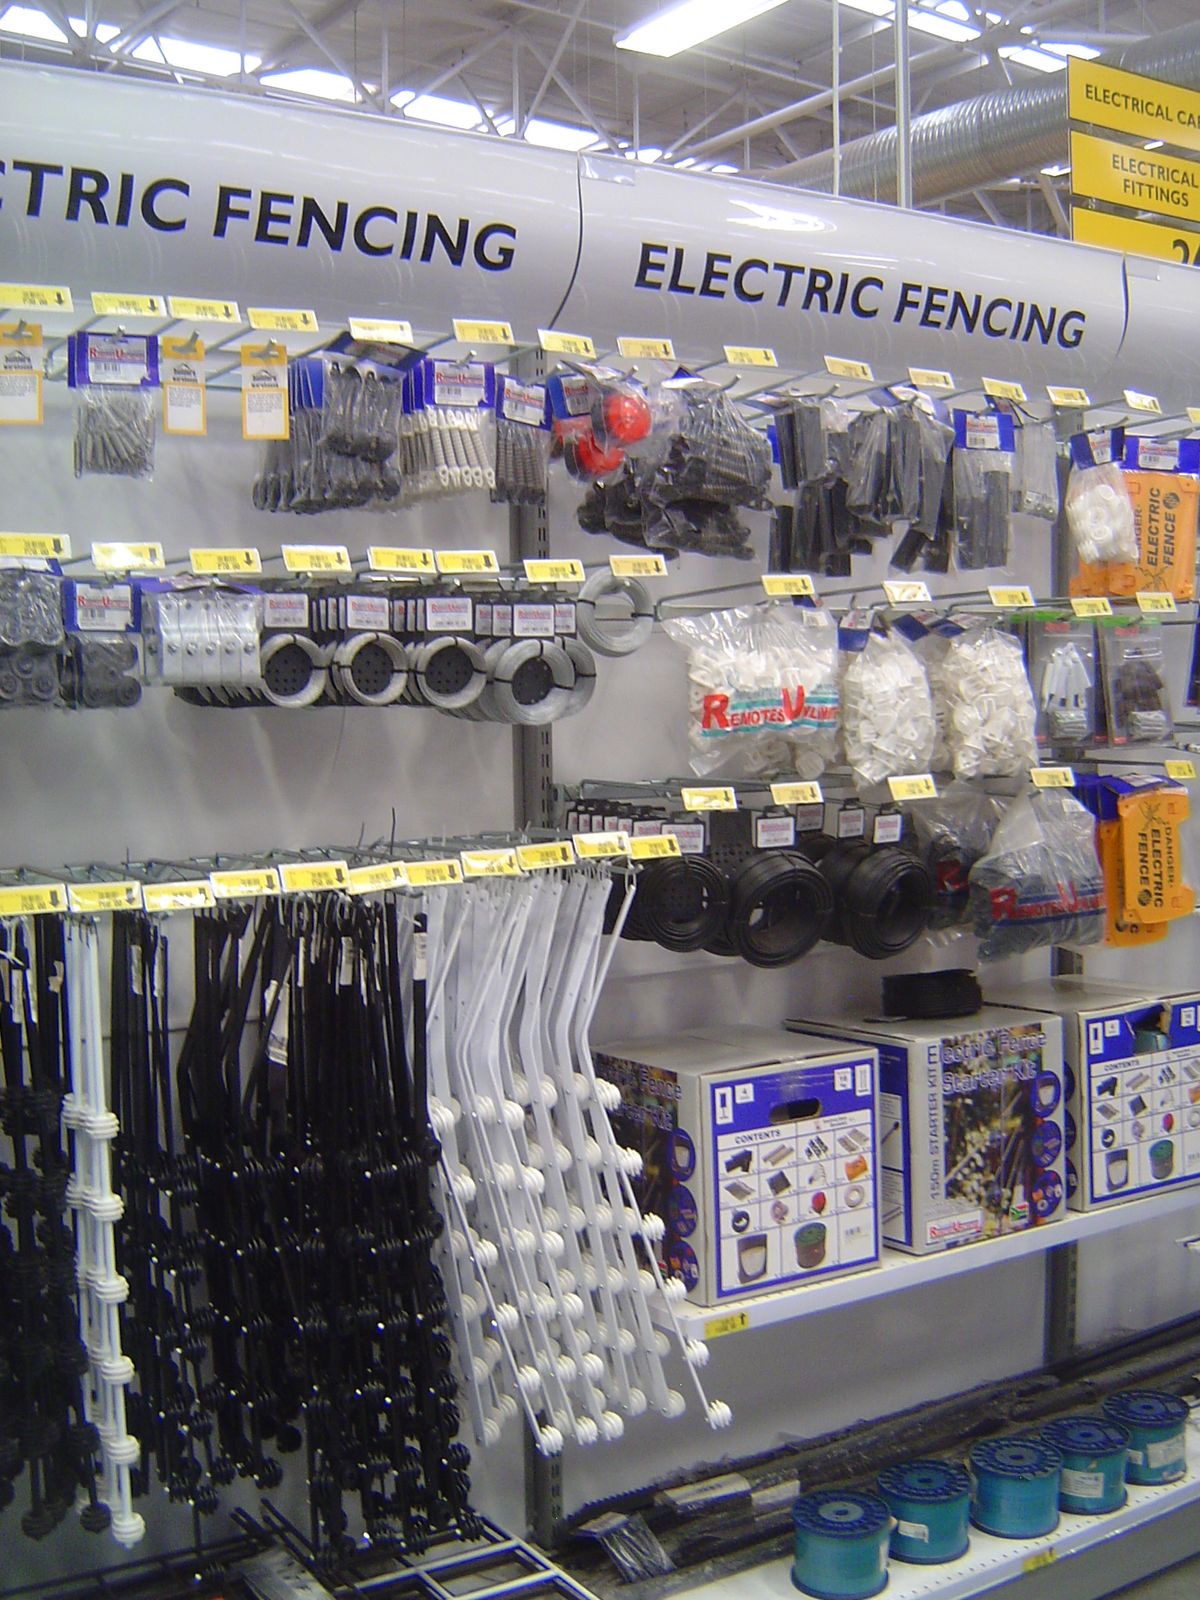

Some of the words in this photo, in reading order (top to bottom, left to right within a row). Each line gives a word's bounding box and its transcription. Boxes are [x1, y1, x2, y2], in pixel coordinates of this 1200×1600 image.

[1085, 84, 1174, 123] ELECTRICAL
[1112, 153, 1199, 188] ELECTRICAL
[1123, 178, 1190, 207] FITTINGS
[0, 159, 190, 232] TRIC
[212, 184, 518, 272] FENCING
[633, 241, 884, 320] ELECTRIC
[893, 282, 1087, 349] FENCING
[1147, 487, 1161, 567] ELECTRIC
[1163, 511, 1176, 566] FENCE
[1138, 832, 1150, 886] FENCE
[1151, 828, 1164, 908] ELECTRIC
[928, 1067, 938, 1088] KIT
[735, 1129, 781, 1145] CONTENTS
[928, 1092, 939, 1155] STARTER
